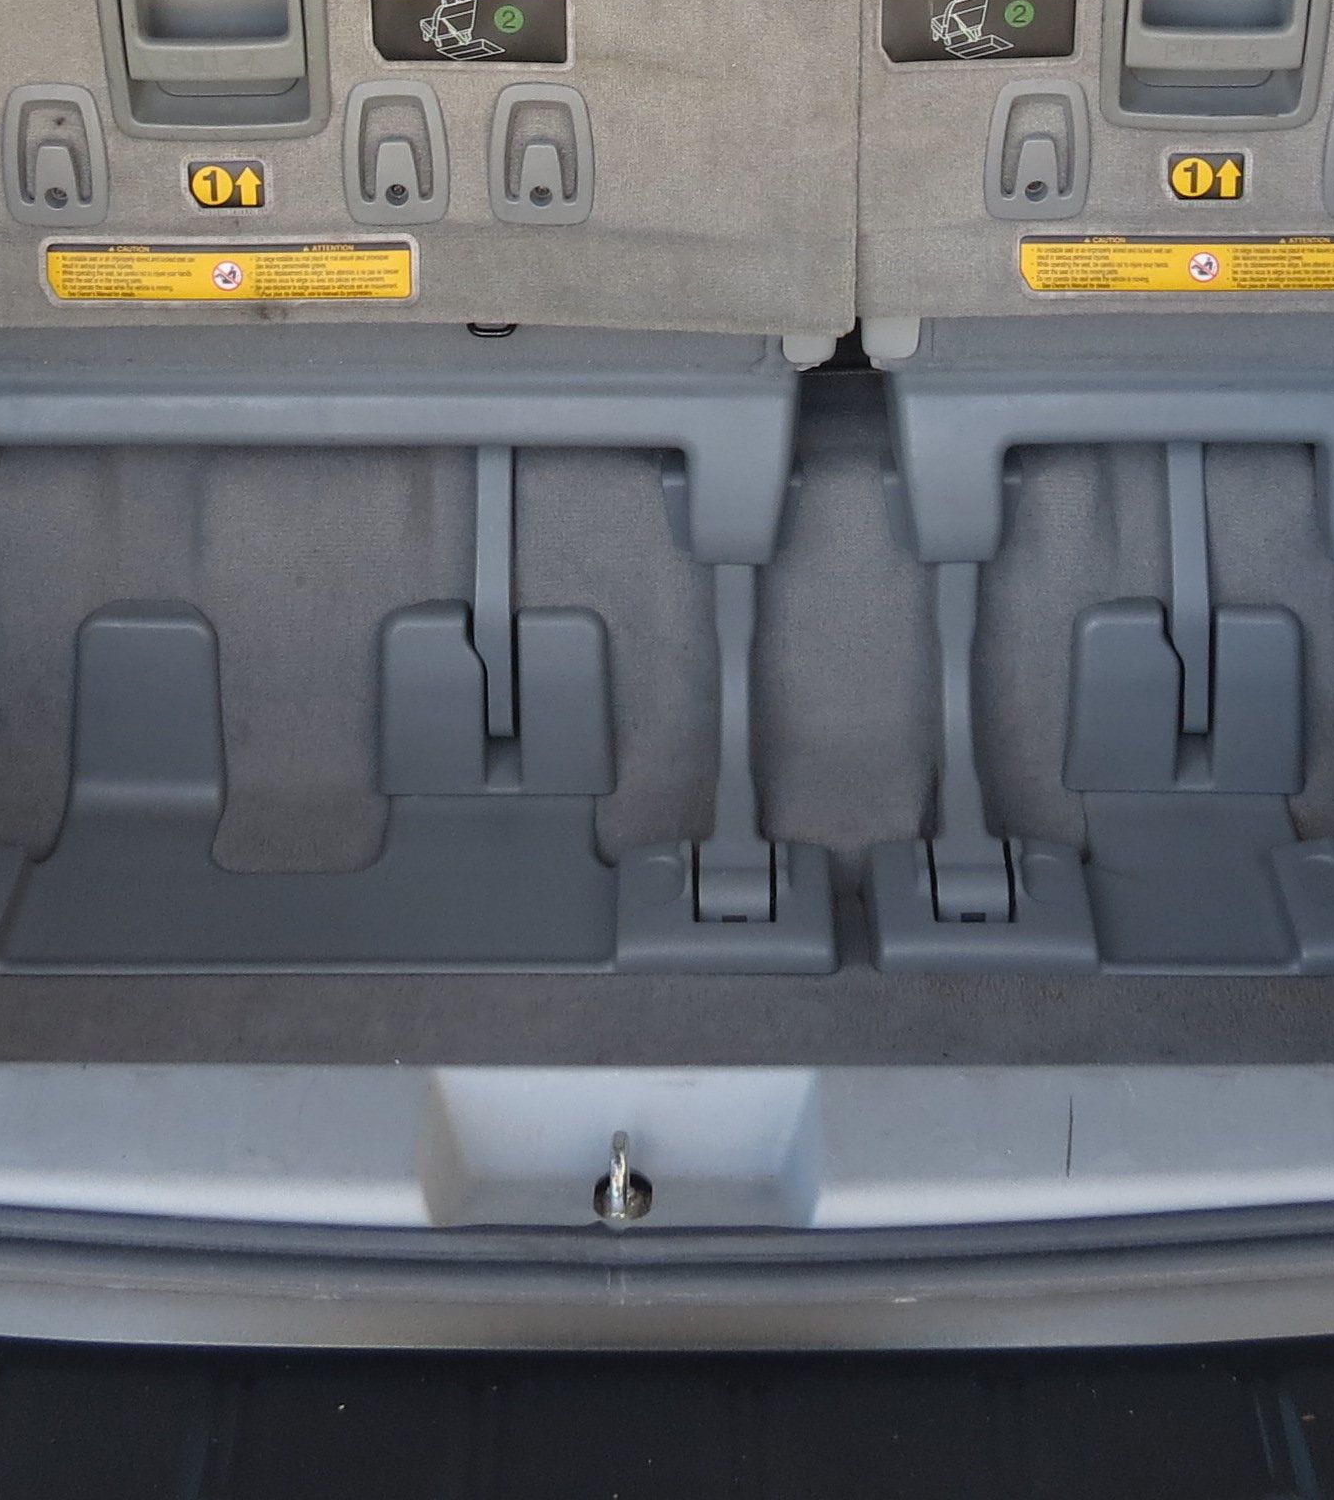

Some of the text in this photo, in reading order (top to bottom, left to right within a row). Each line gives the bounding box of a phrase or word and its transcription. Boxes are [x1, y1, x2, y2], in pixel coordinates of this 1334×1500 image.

[502, 11, 516, 28] 2
[1013, 6, 1027, 23] 2
[203, 170, 219, 202] 1
[1183, 162, 1199, 194] 1
